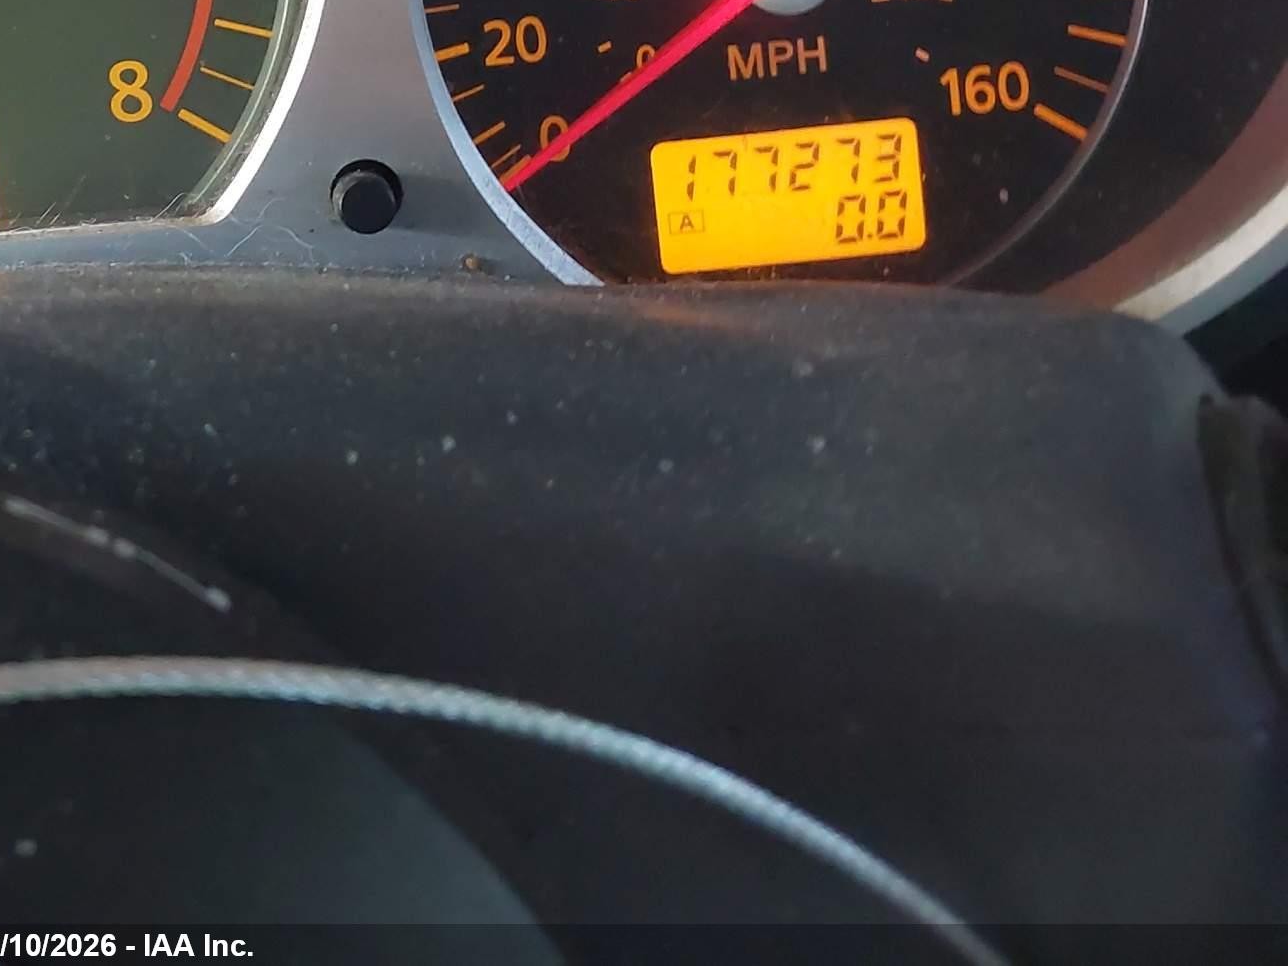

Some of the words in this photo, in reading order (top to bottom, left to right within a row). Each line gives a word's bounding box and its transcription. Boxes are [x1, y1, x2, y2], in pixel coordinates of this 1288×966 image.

[483, 15, 547, 67] 20
[727, 35, 827, 81] MPH
[108, 59, 154, 123] 8
[940, 61, 1030, 116] 160
[539, 114, 571, 163] 0
[685, 134, 902, 203] 177273
[679, 214, 695, 231] A
[834, 190, 908, 245] 0.0
